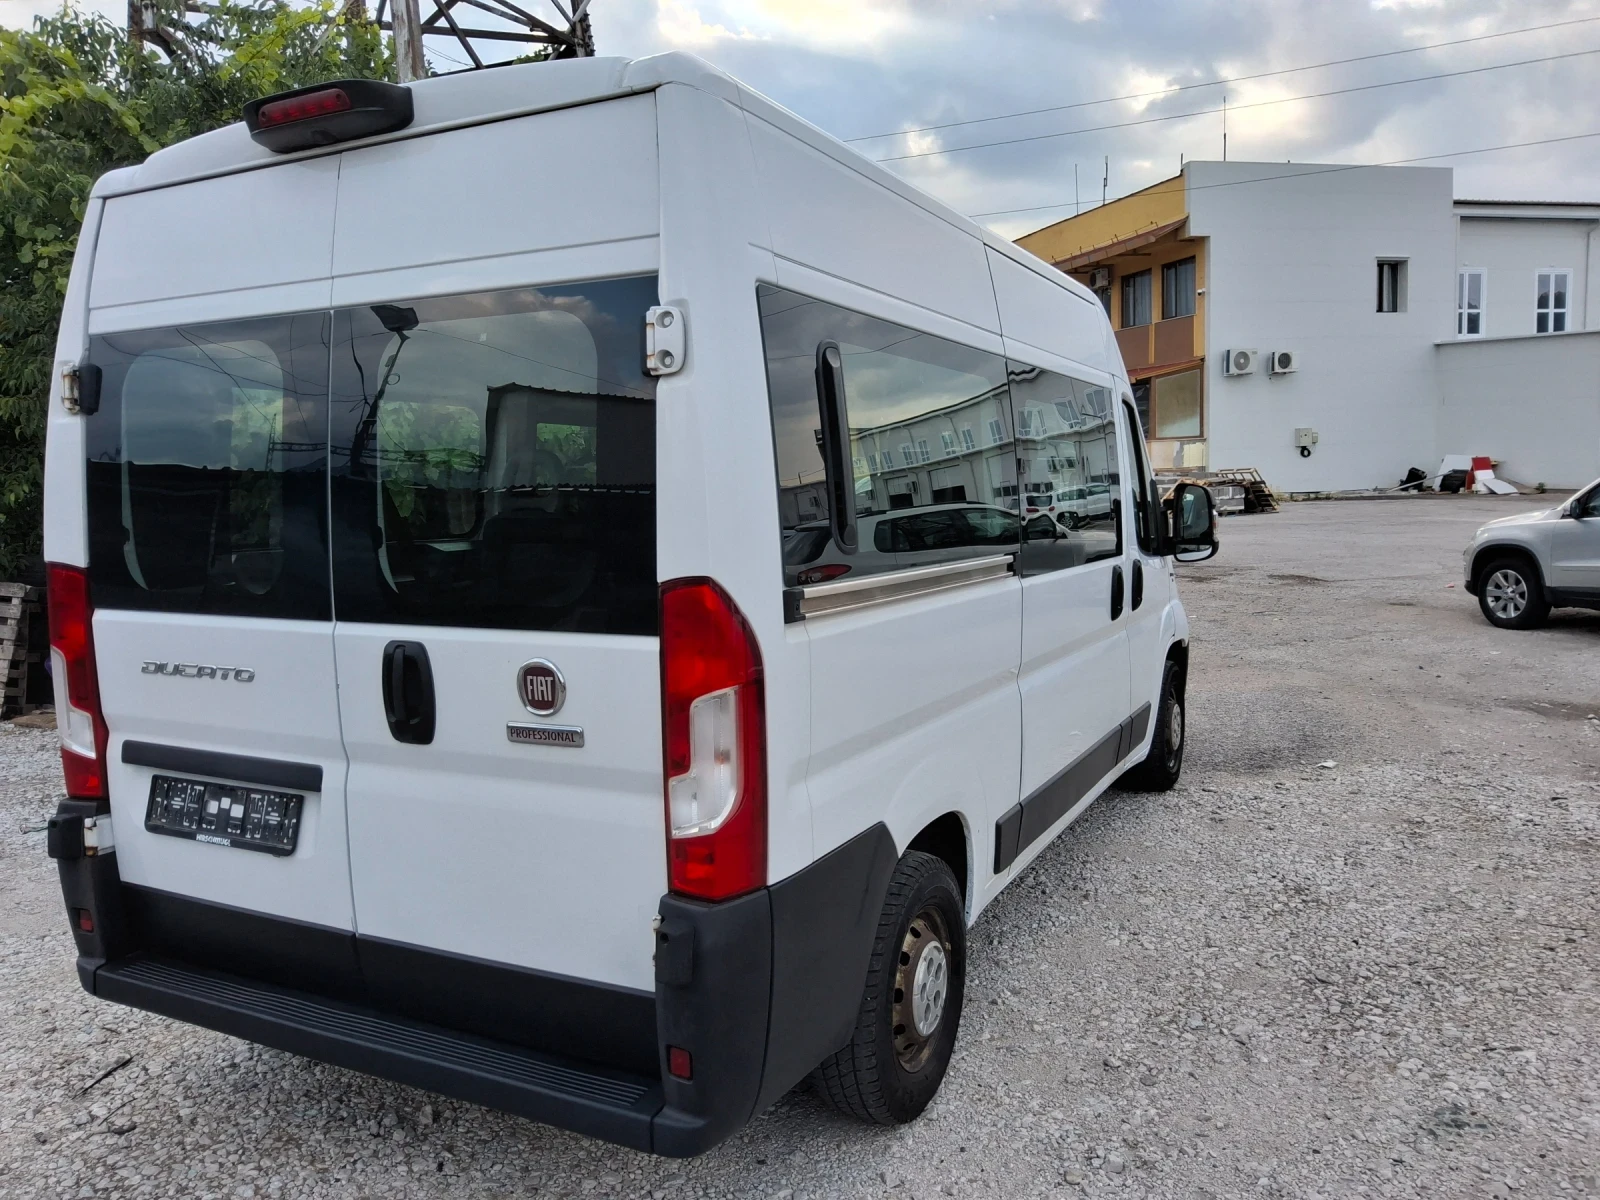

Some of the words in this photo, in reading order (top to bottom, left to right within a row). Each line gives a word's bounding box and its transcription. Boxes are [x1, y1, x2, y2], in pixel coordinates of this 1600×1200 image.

[141, 660, 255, 682] DUCATO
[526, 675, 553, 701] FIAT
[510, 728, 576, 742] PROFESSIONAL
